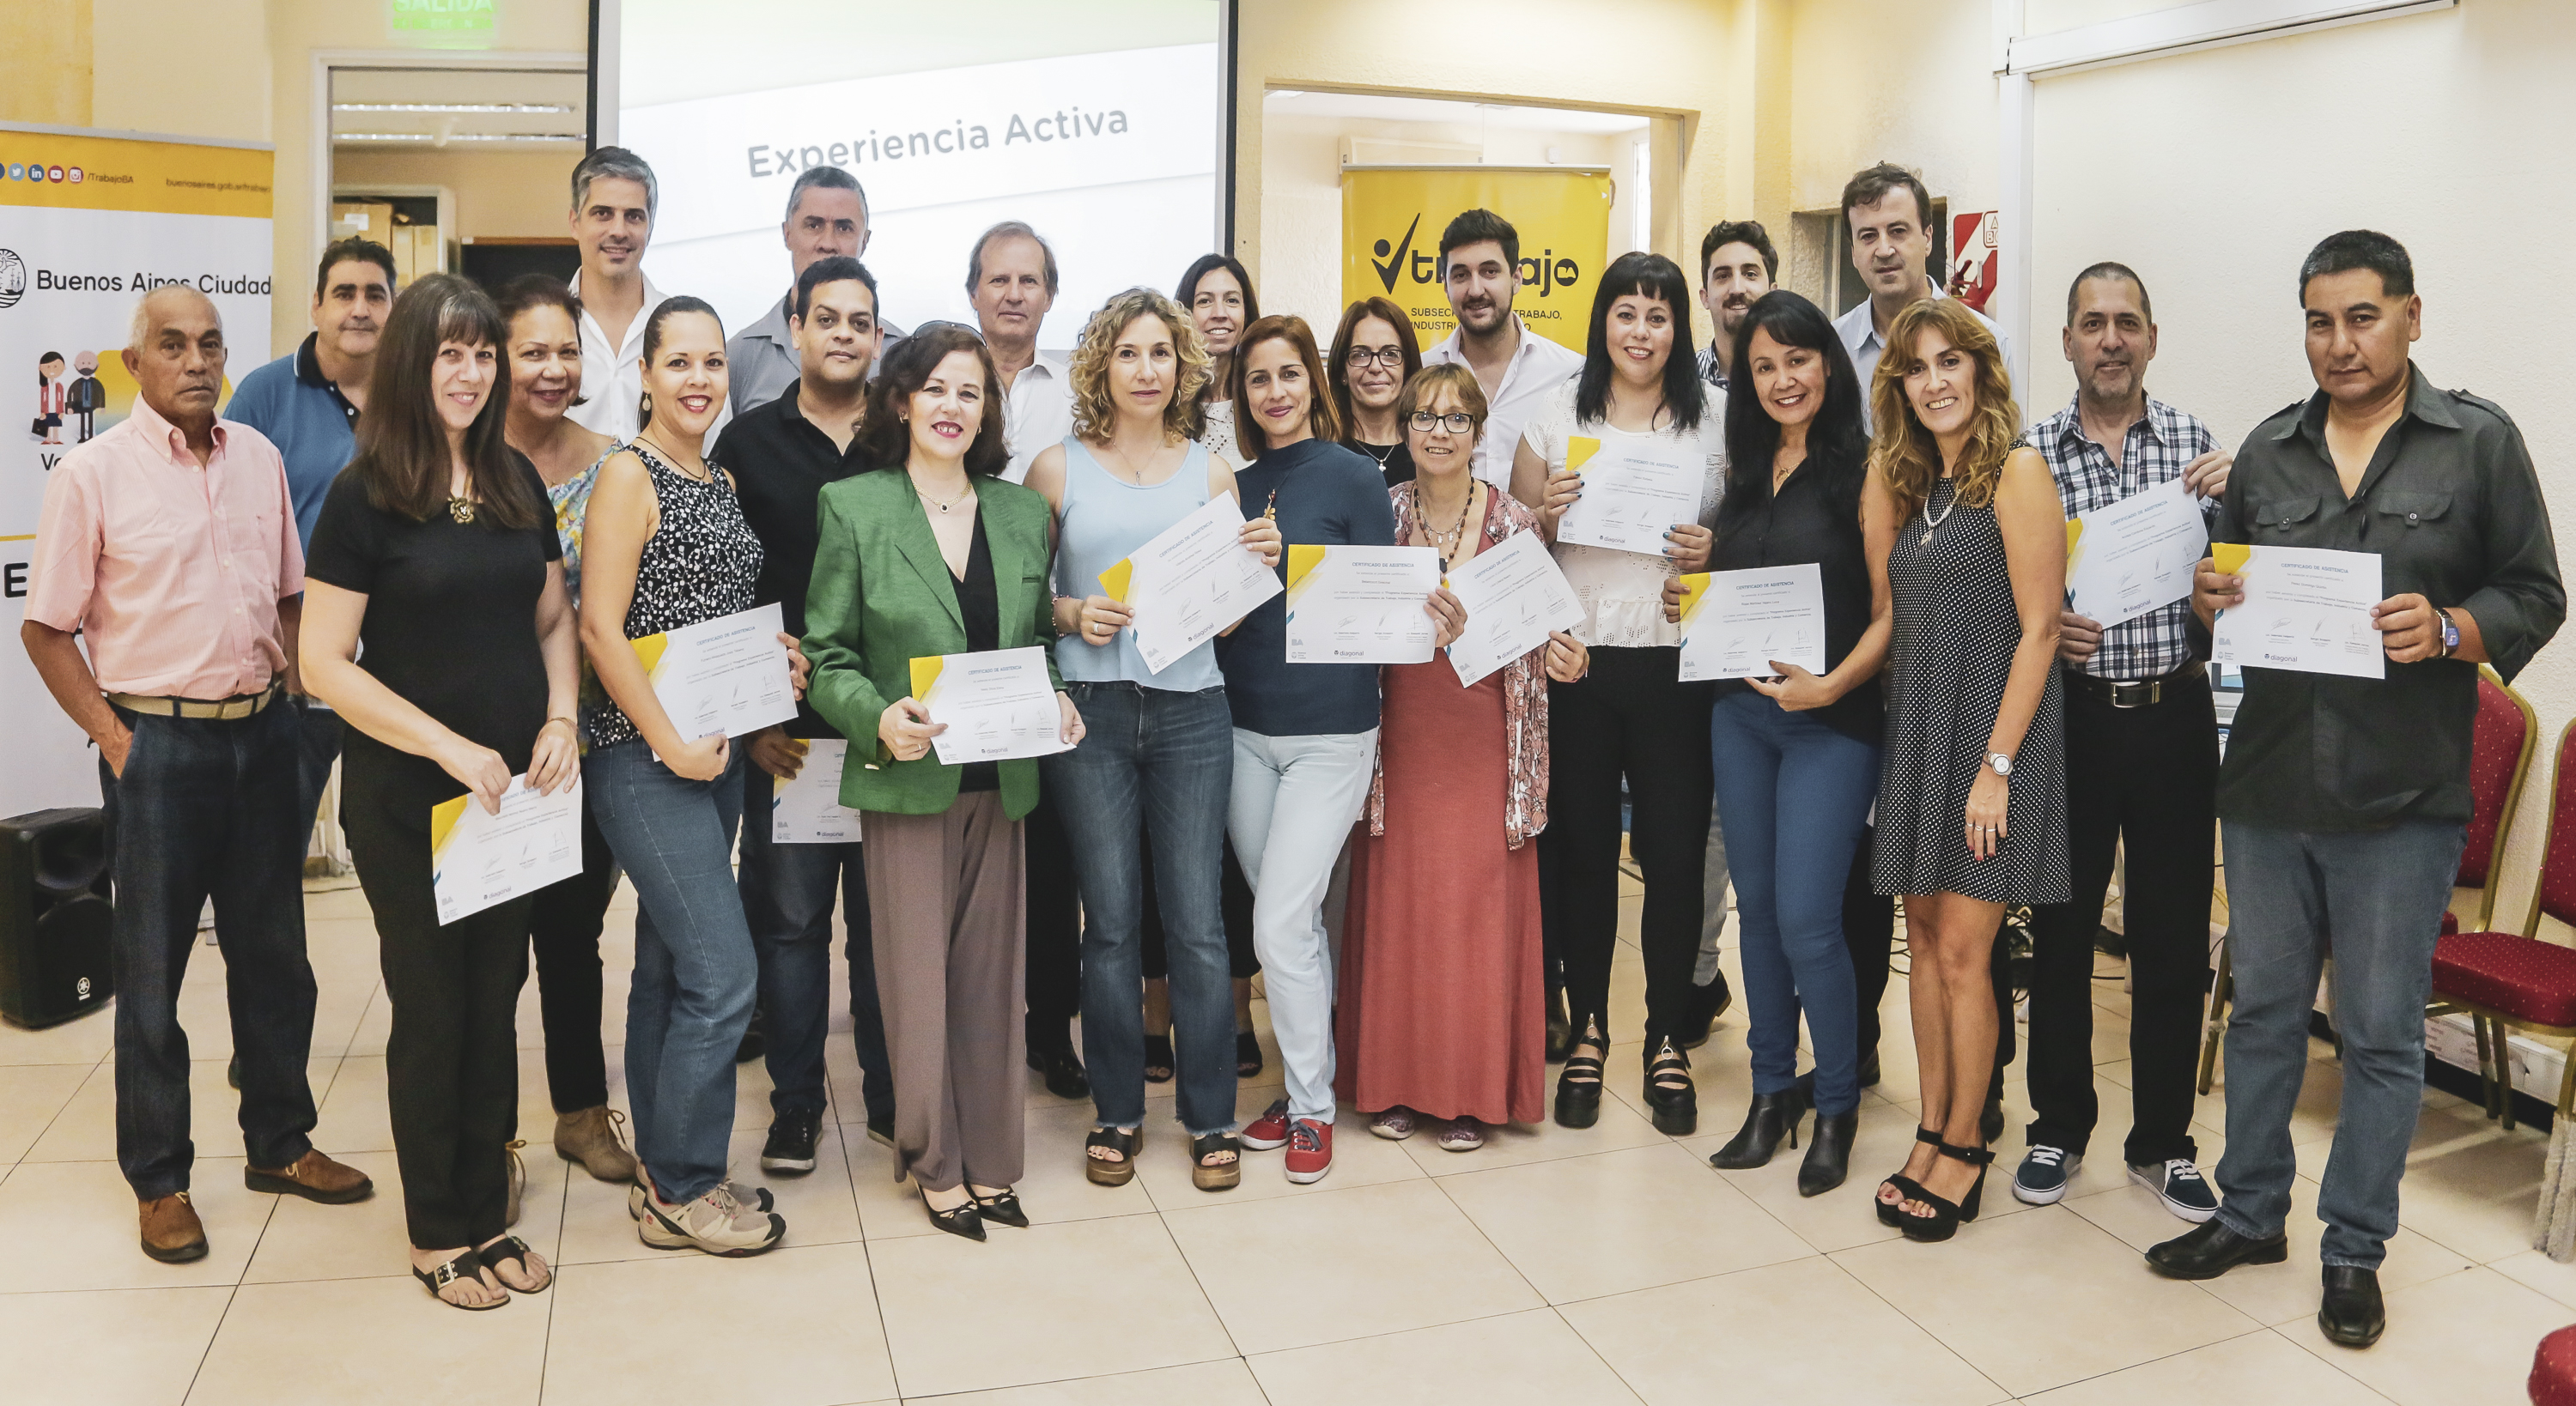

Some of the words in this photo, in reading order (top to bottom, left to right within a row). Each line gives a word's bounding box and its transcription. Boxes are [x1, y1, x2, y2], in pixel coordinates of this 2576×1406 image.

[748, 118, 989, 179] Experiencia
[1005, 106, 1128, 146] Activa
[37, 270, 123, 292] Buenos
[198, 274, 271, 295] Ciudad
